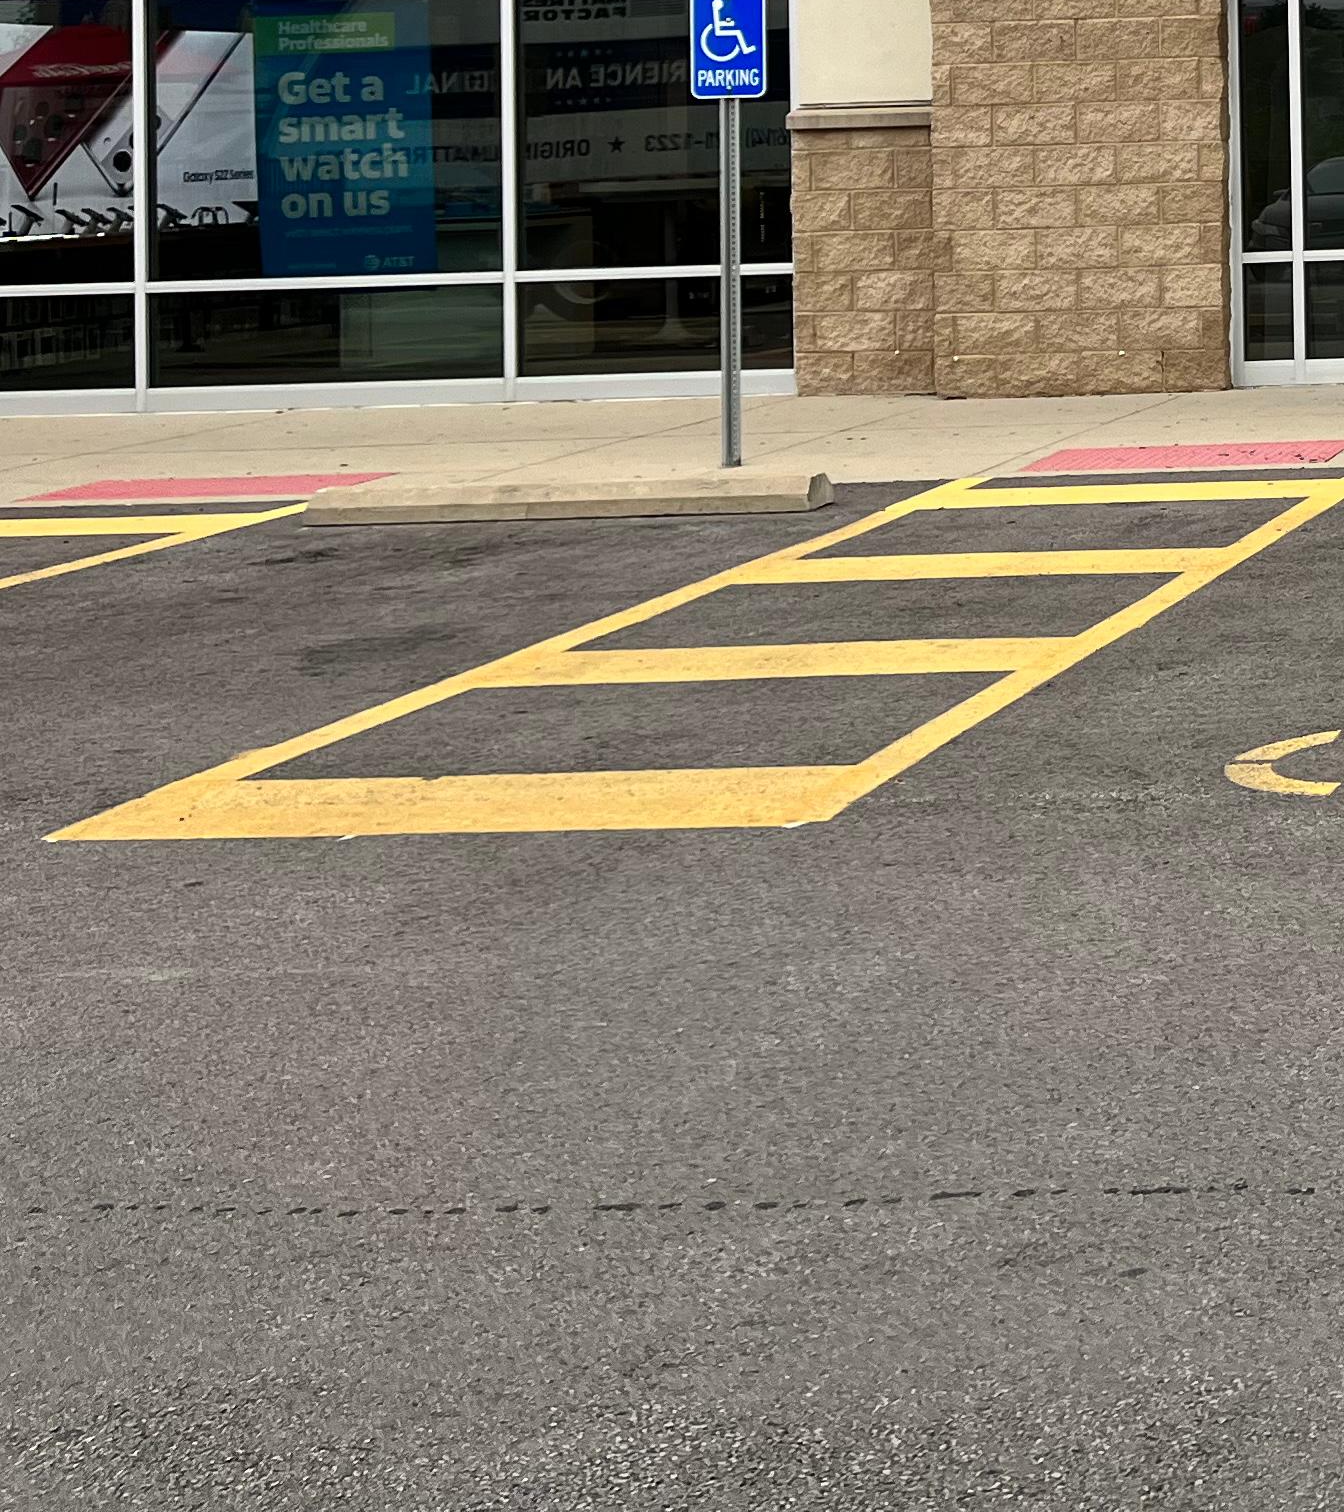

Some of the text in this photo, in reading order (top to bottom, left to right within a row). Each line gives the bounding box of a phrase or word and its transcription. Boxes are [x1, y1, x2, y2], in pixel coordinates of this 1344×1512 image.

[278, 20, 368, 34] Healthcare
[279, 34, 388, 51] Professionals
[278, 71, 384, 105] Get a
[697, 68, 760, 87] PARKING
[278, 107, 405, 144] smart
[279, 143, 408, 182] watch
[281, 190, 390, 218] on us
